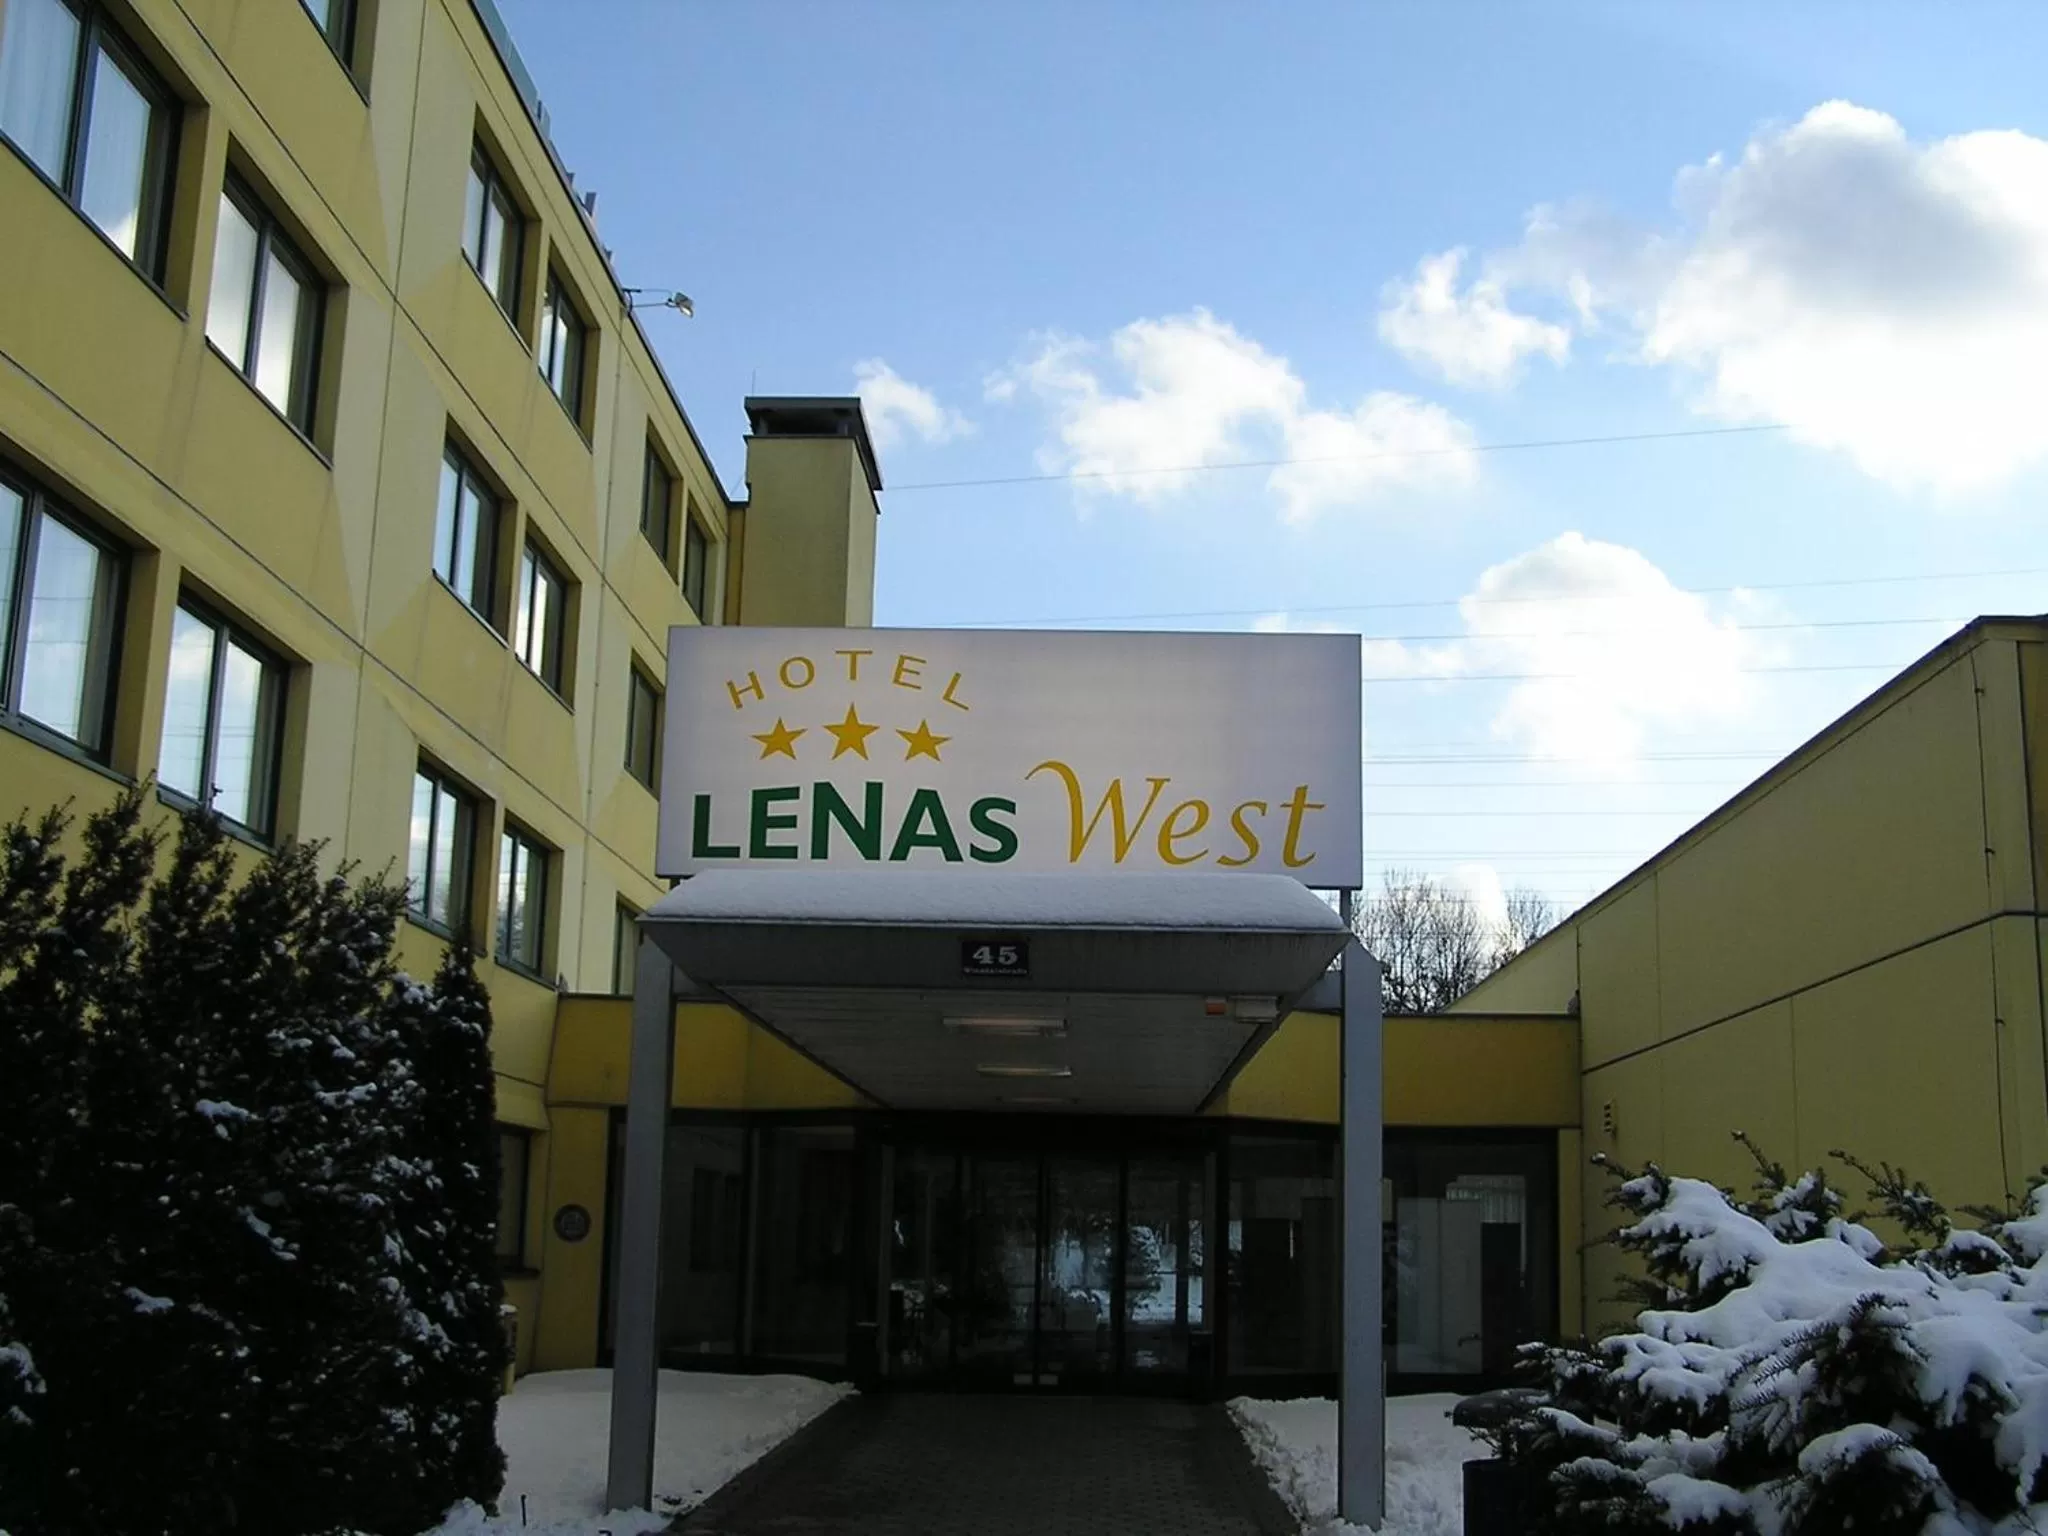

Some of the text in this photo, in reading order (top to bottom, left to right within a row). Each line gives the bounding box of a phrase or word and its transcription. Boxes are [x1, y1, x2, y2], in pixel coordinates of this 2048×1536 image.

[726, 650, 970, 711] HOTEL
[692, 760, 1325, 868] LENAS West
[972, 945, 1018, 965] 45
